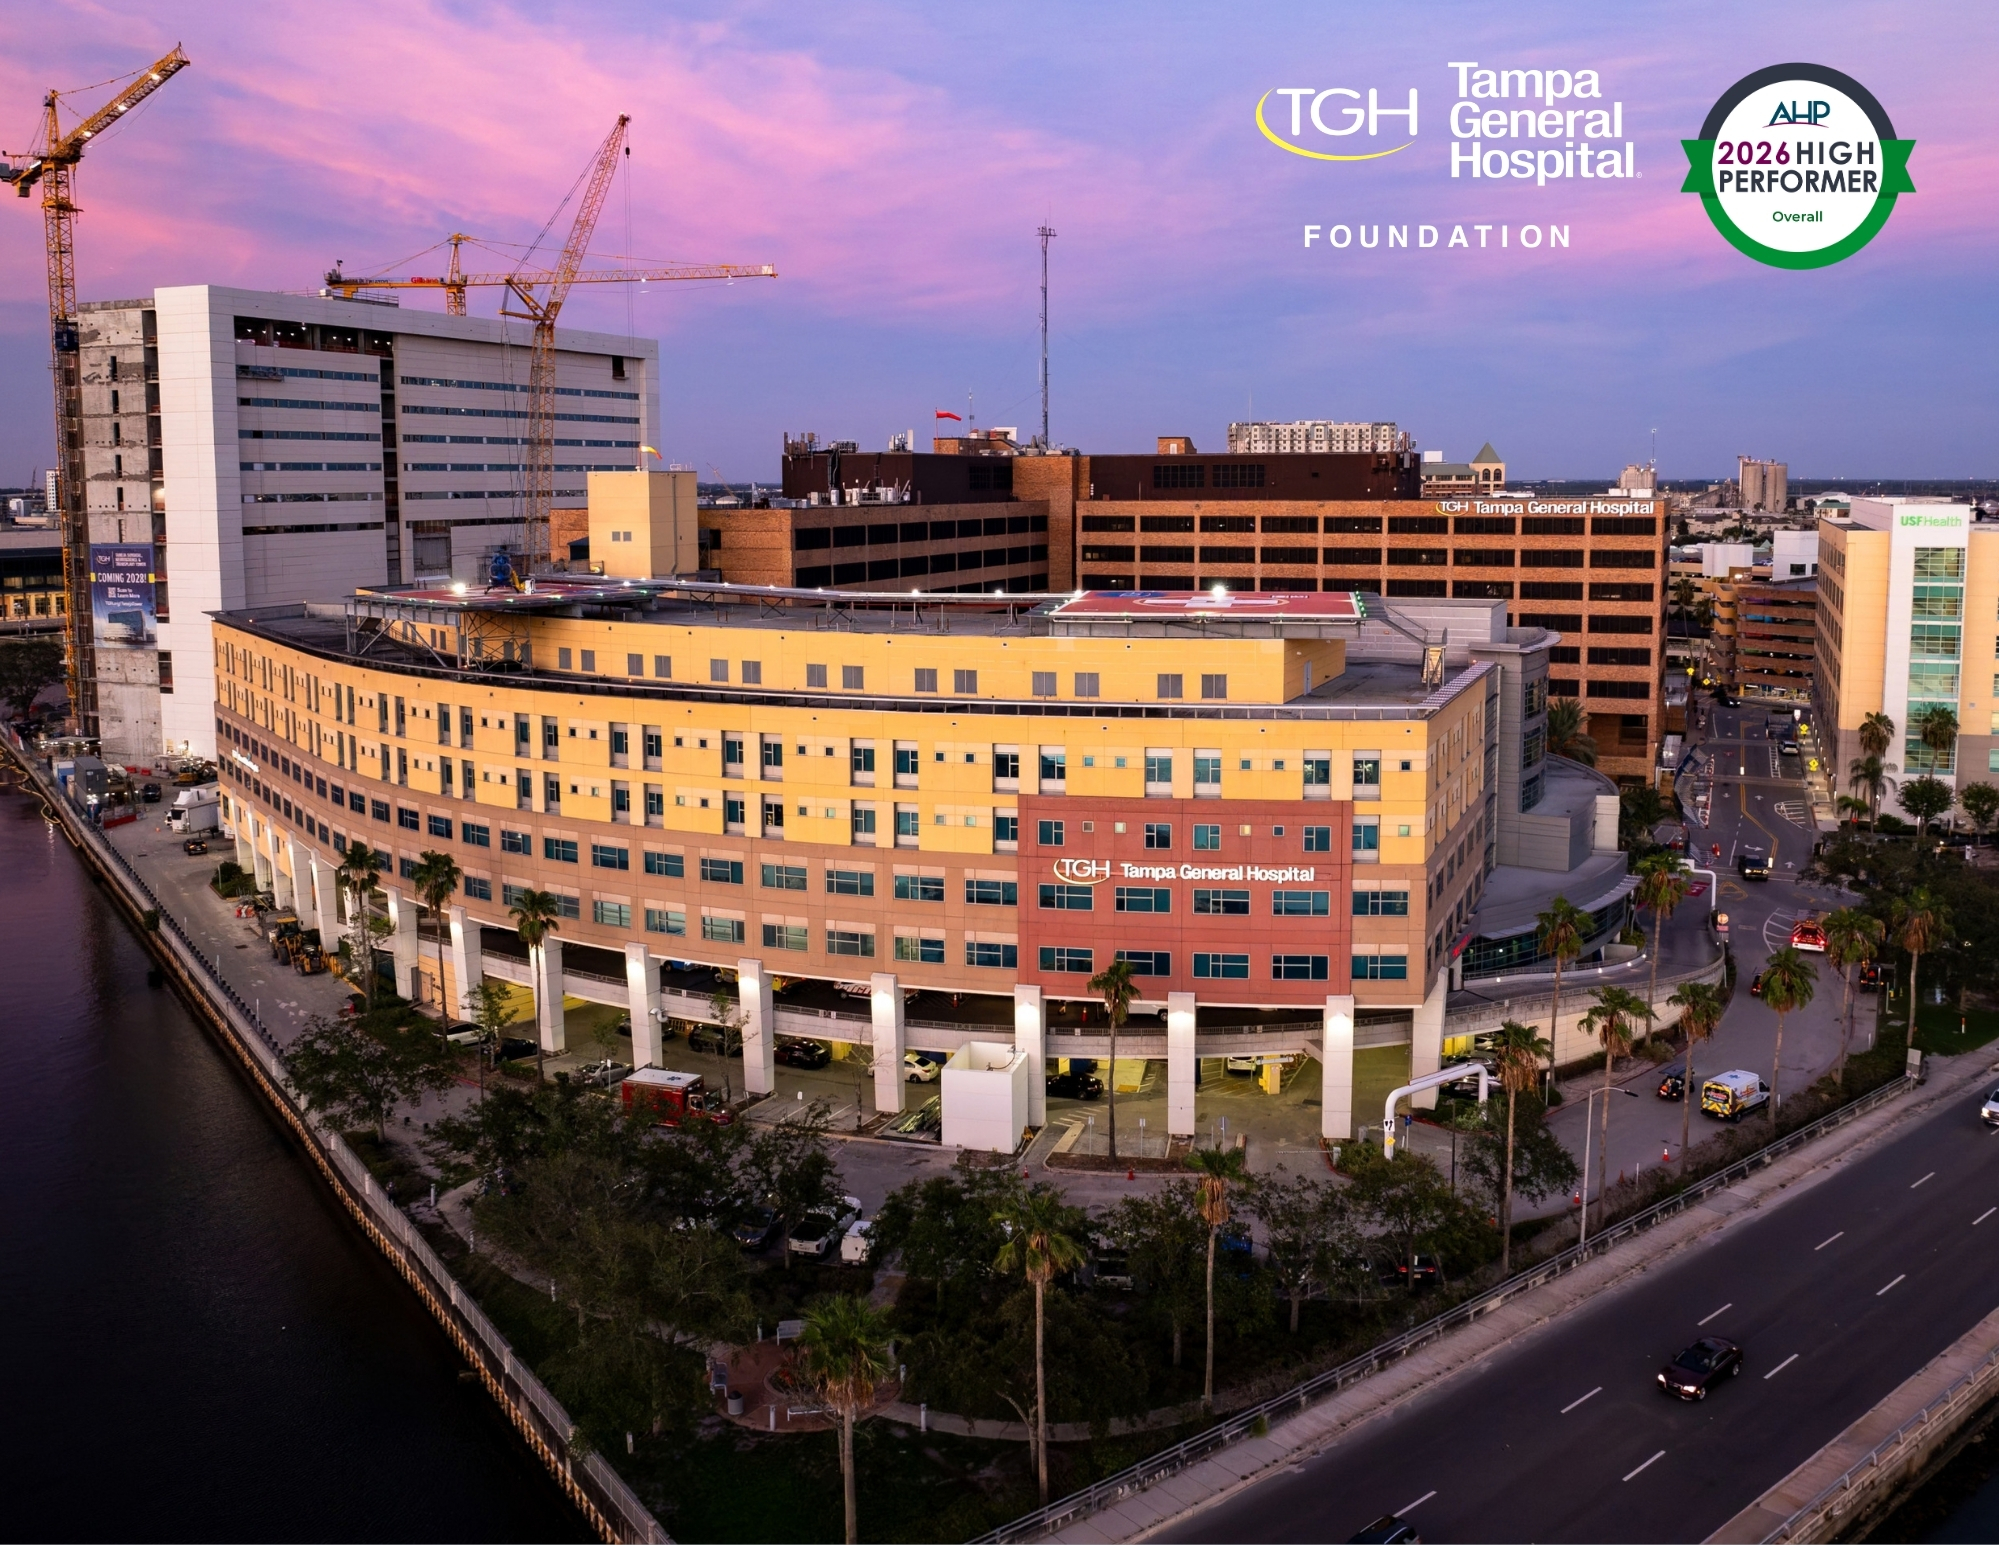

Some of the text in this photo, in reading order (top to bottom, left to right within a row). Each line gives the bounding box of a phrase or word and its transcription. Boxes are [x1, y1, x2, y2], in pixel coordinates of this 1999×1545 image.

[1440, 500, 1654, 516] TGH Tampa General Hospital
[98, 573, 147, 583] COMING 2028!
[1061, 858, 1314, 884] TGH Tampa General Hospital
